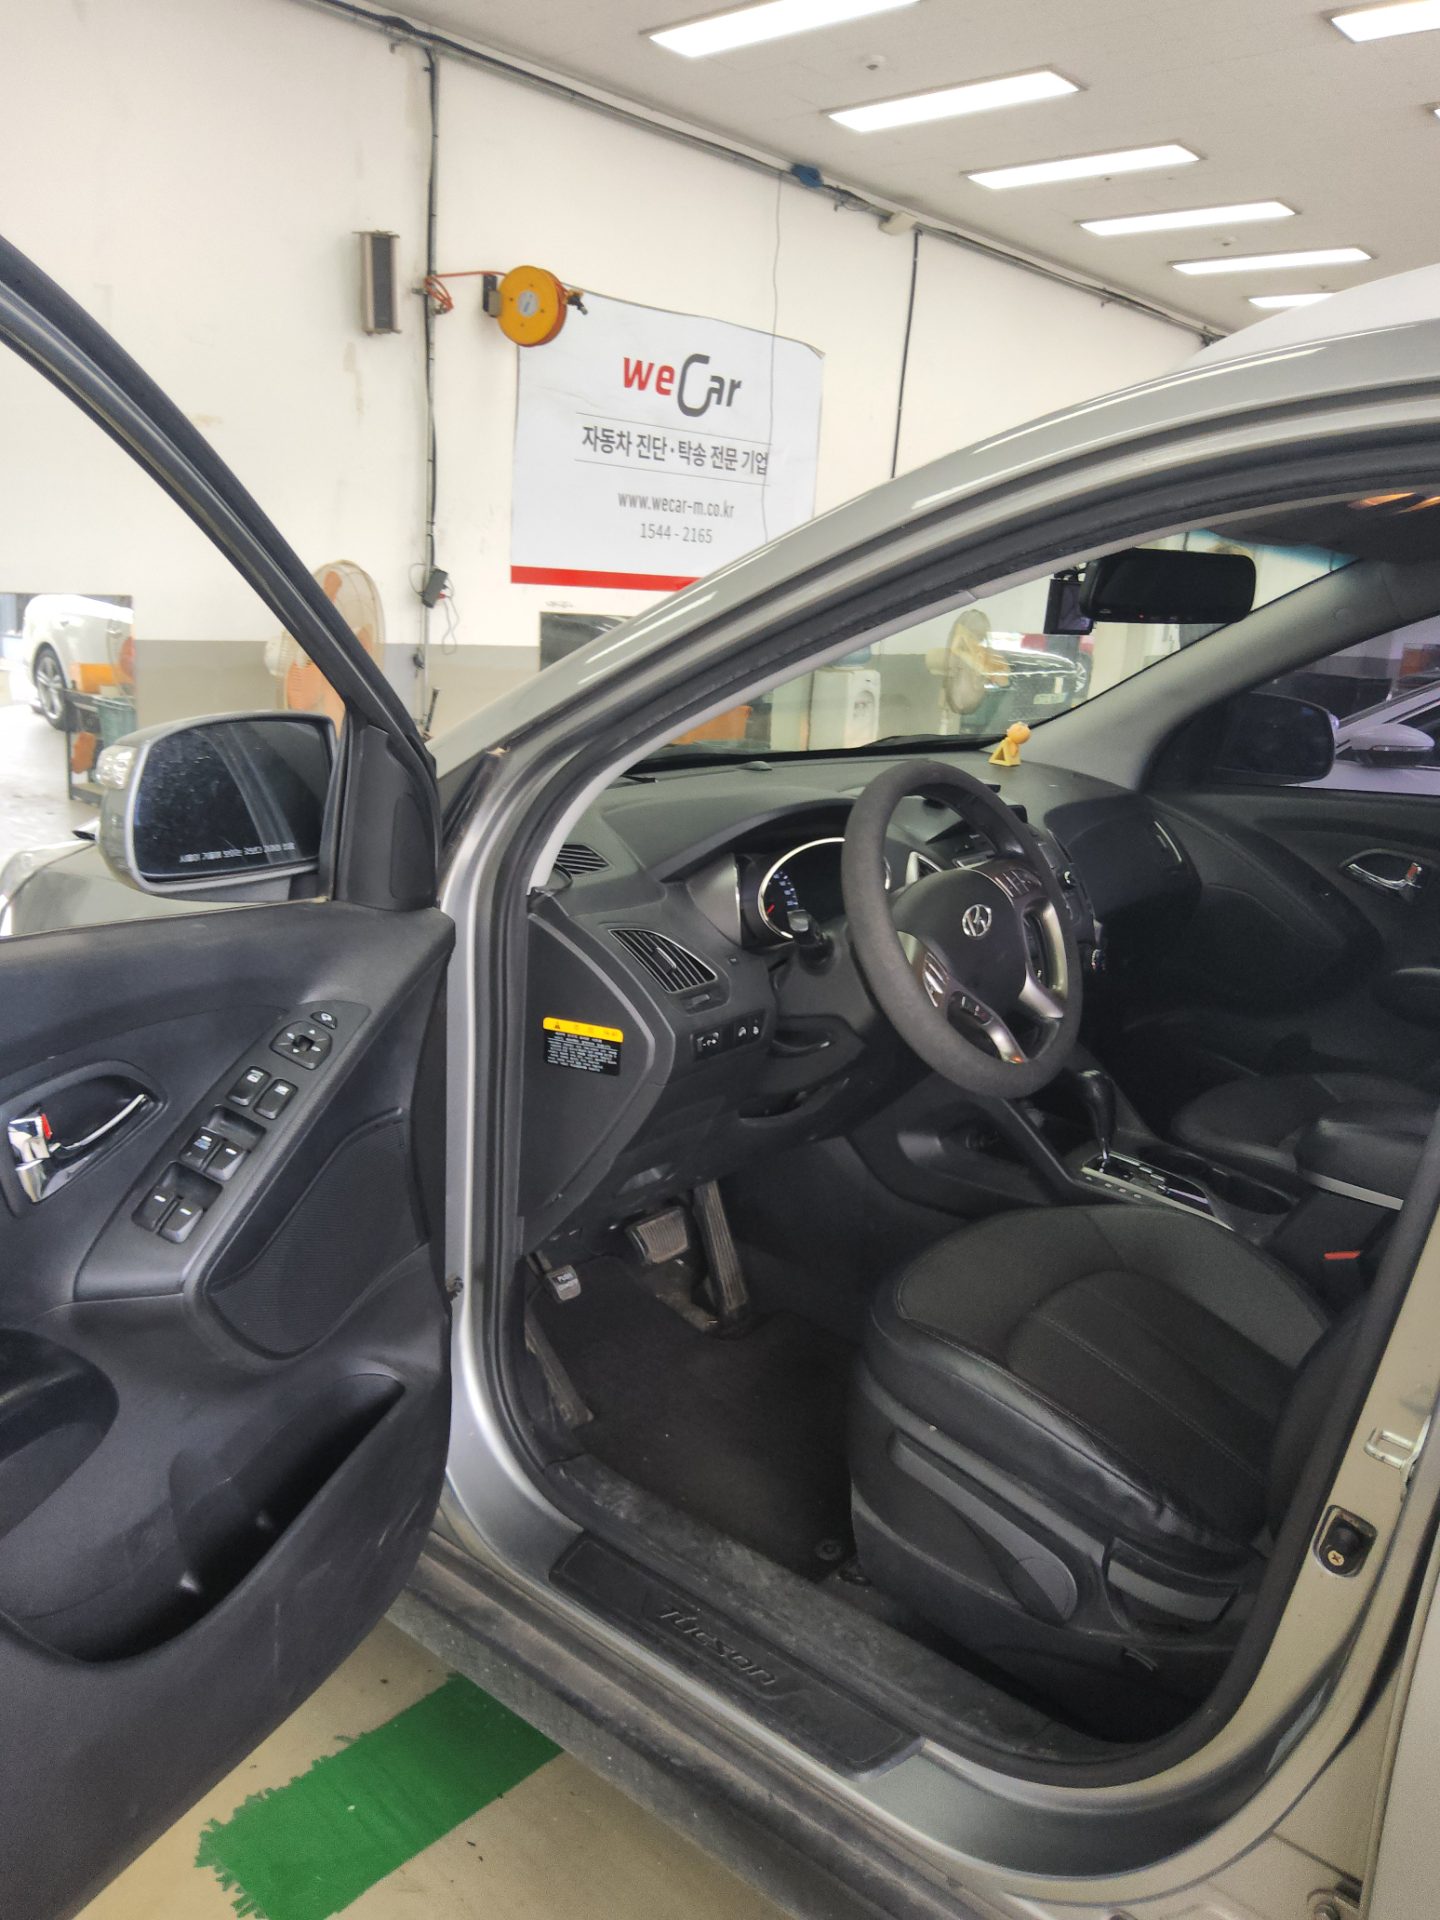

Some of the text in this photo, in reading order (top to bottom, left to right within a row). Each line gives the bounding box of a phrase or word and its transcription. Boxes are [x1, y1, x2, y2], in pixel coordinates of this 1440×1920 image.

[582, 425, 632, 457] 자동차
[710, 445, 739, 472] 전문
[741, 450, 768, 476] 기업
[617, 492, 734, 519] www.wecar-m.co.kr
